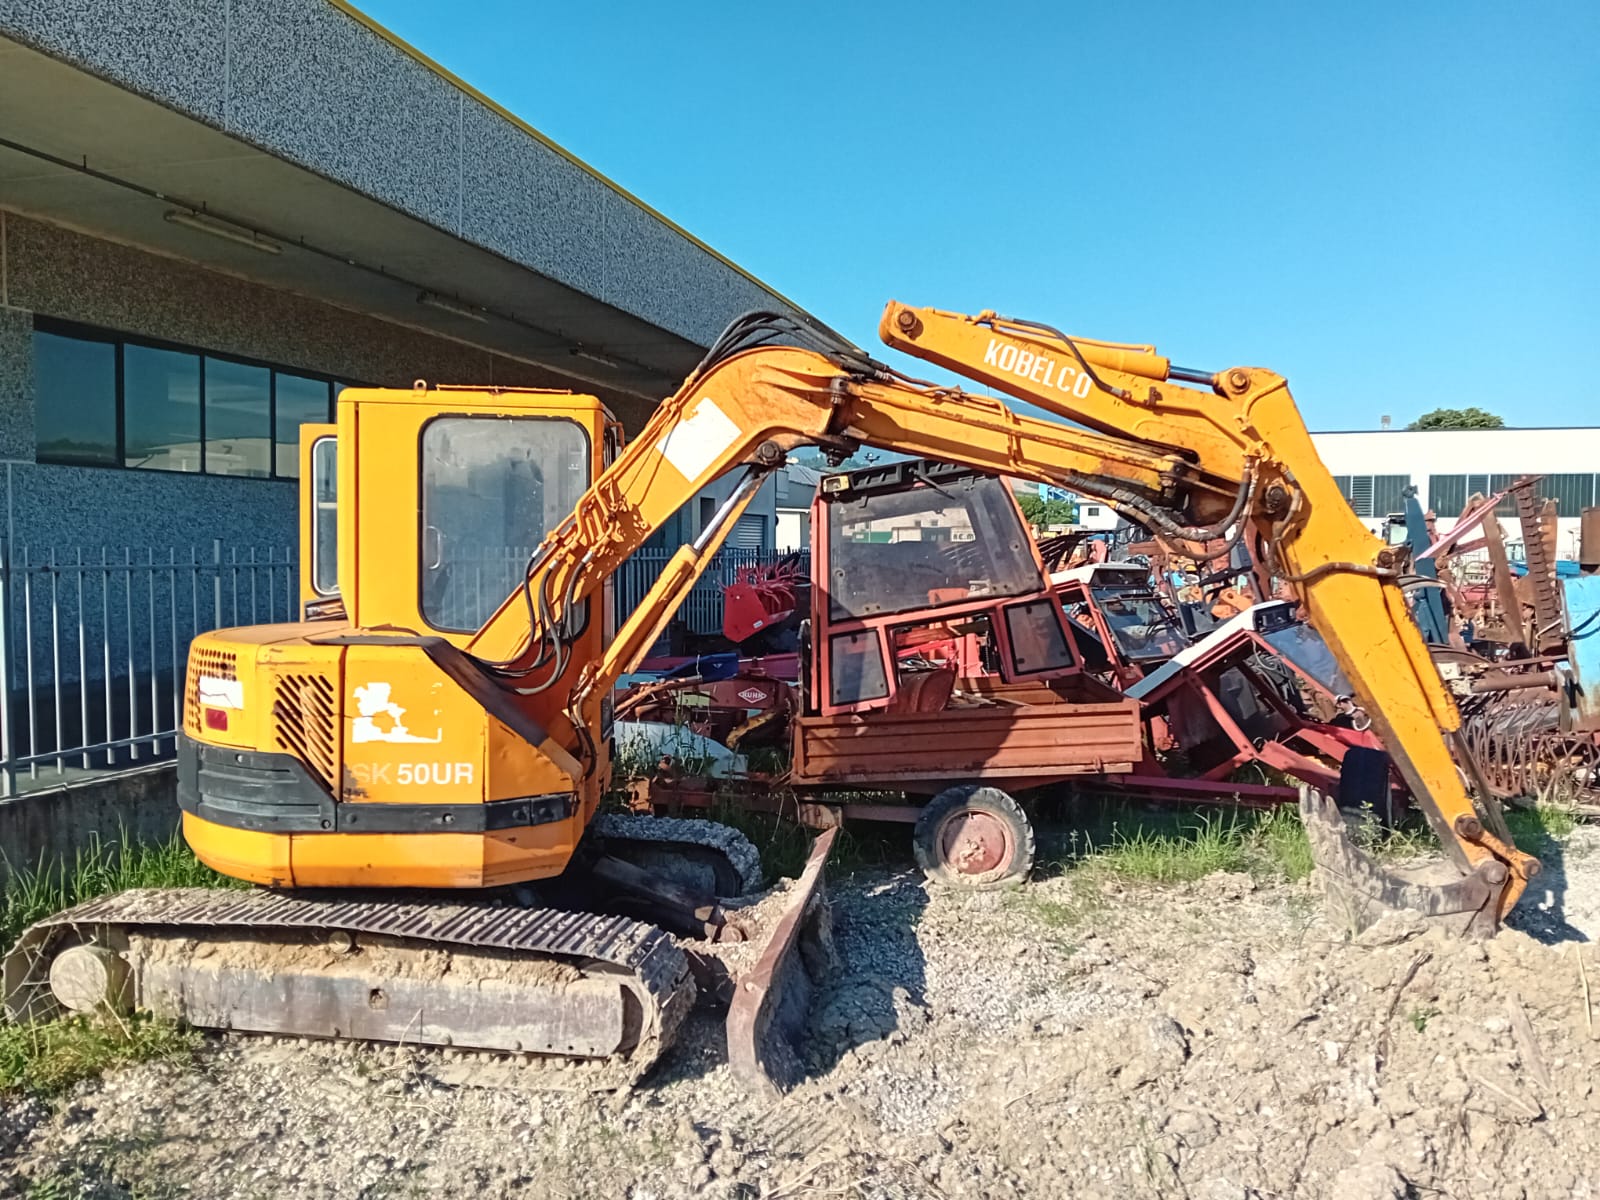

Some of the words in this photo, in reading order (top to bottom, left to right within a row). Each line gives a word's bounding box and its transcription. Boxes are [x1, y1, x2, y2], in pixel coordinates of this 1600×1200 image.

[983, 338, 1093, 399] KOBELCO
[351, 763, 393, 785] SK
[396, 762, 474, 785] 50UR
